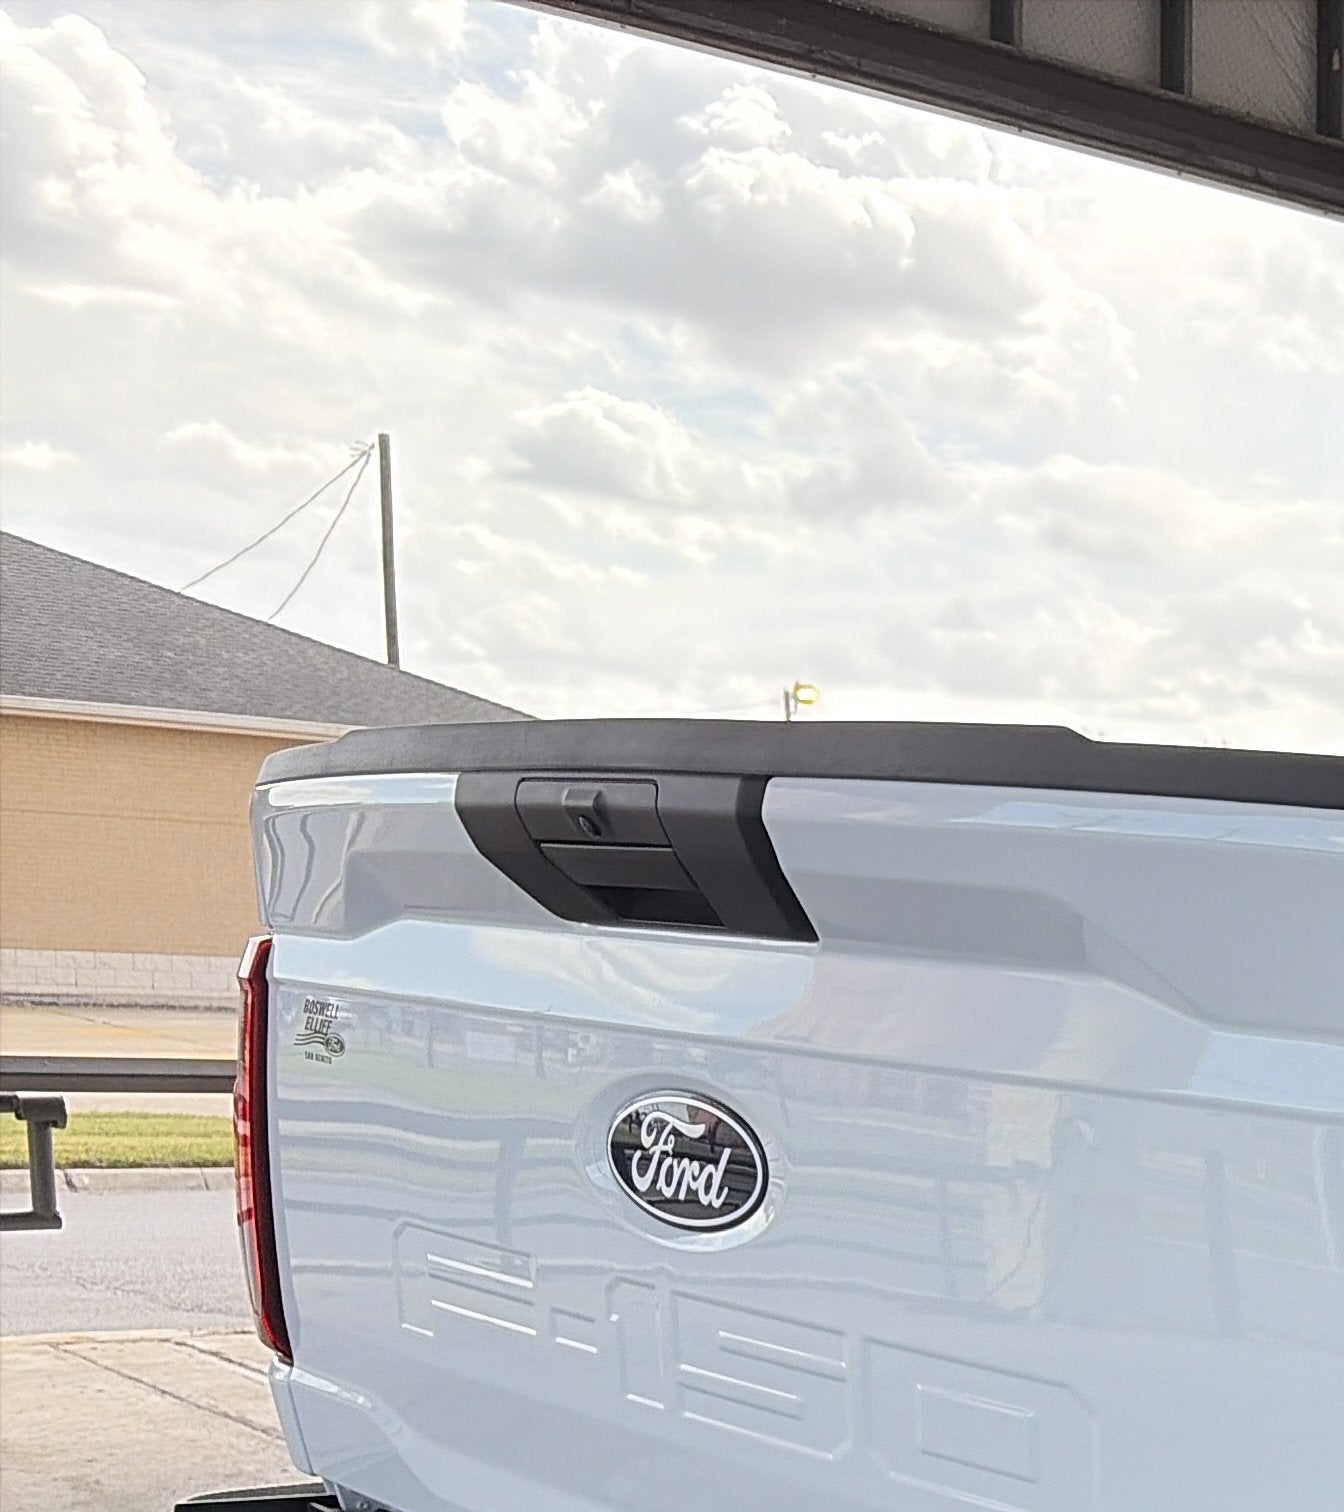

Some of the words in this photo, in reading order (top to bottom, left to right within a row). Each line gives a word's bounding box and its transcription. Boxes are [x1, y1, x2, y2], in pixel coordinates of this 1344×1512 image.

[303, 999, 340, 1019] BOSWELL
[304, 1016, 333, 1036] ELLIFF
[631, 1111, 732, 1209] Ford
